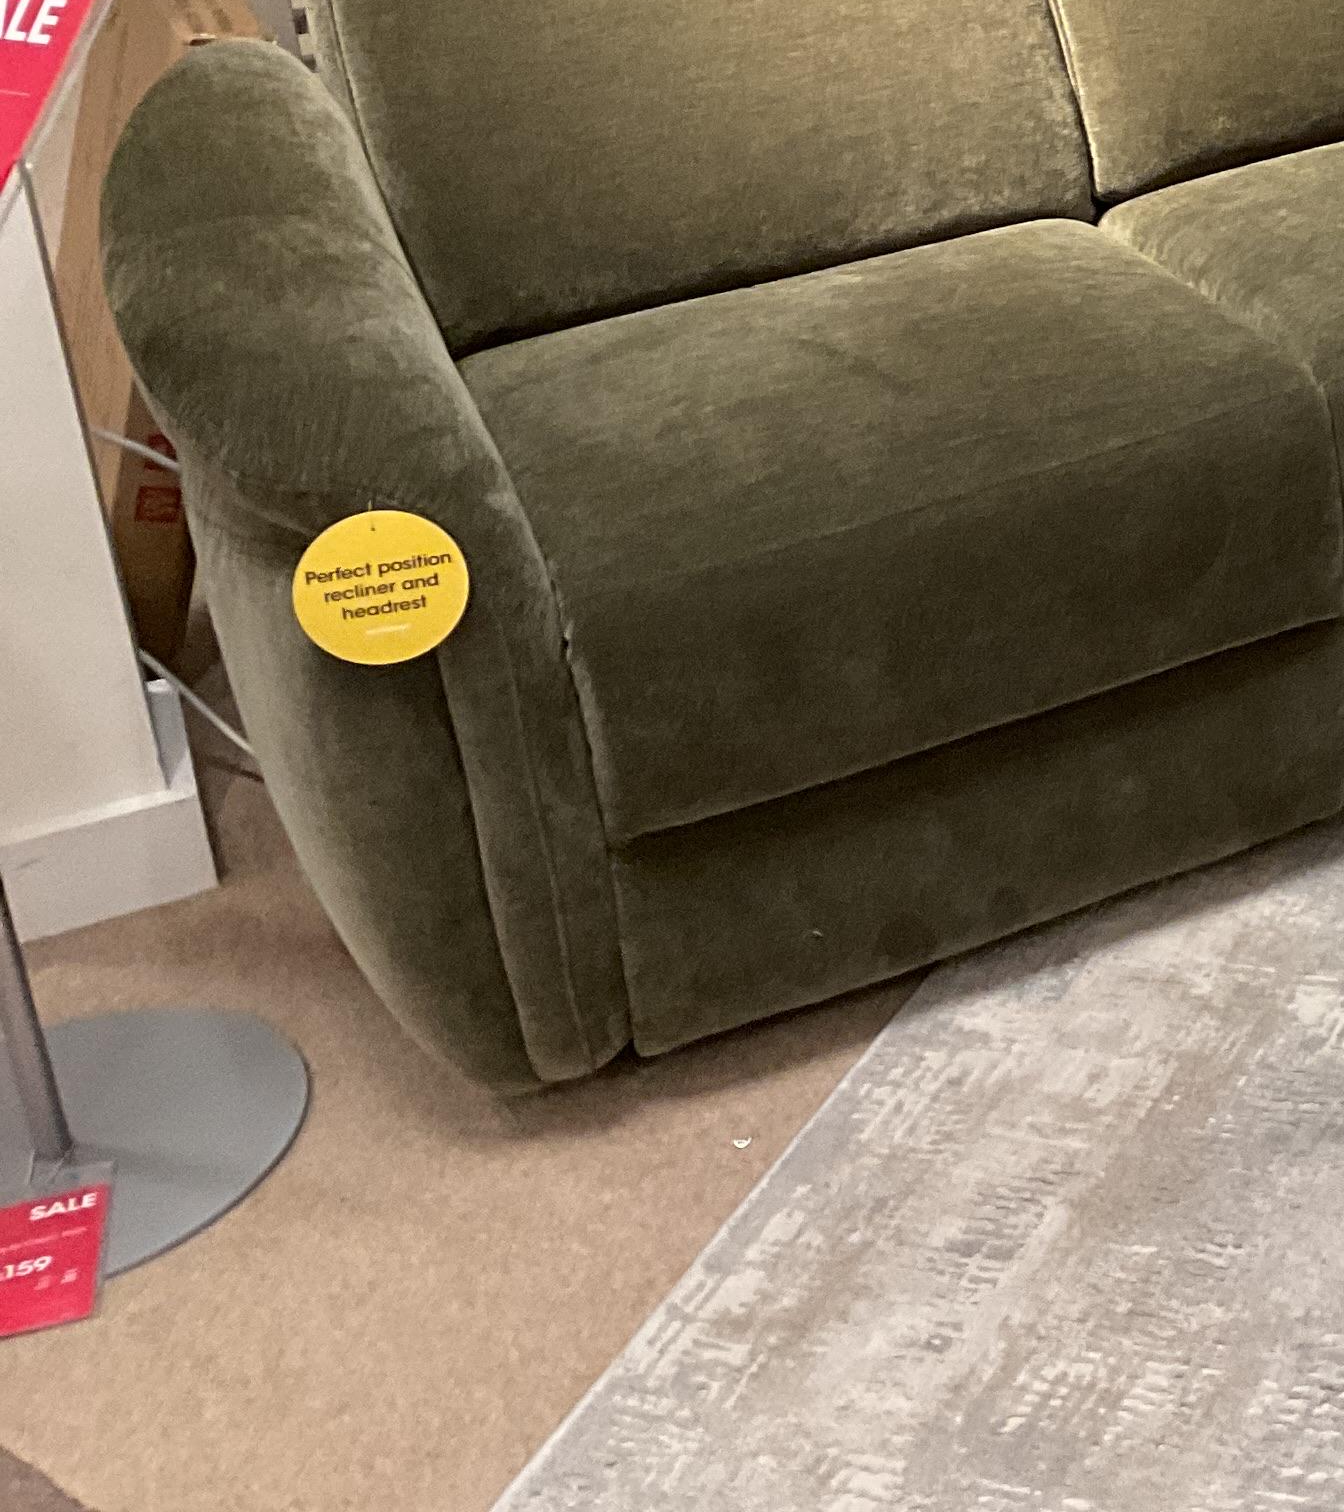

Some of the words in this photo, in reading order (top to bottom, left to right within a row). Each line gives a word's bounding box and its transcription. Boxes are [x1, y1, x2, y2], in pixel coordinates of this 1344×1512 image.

[305, 562, 371, 585] Perfect
[378, 553, 452, 577] position
[324, 580, 396, 603] recliner
[402, 573, 439, 590] and
[342, 595, 427, 620] headrest
[29, 1192, 98, 1221] SALE
[0, 1255, 54, 1282] 159
